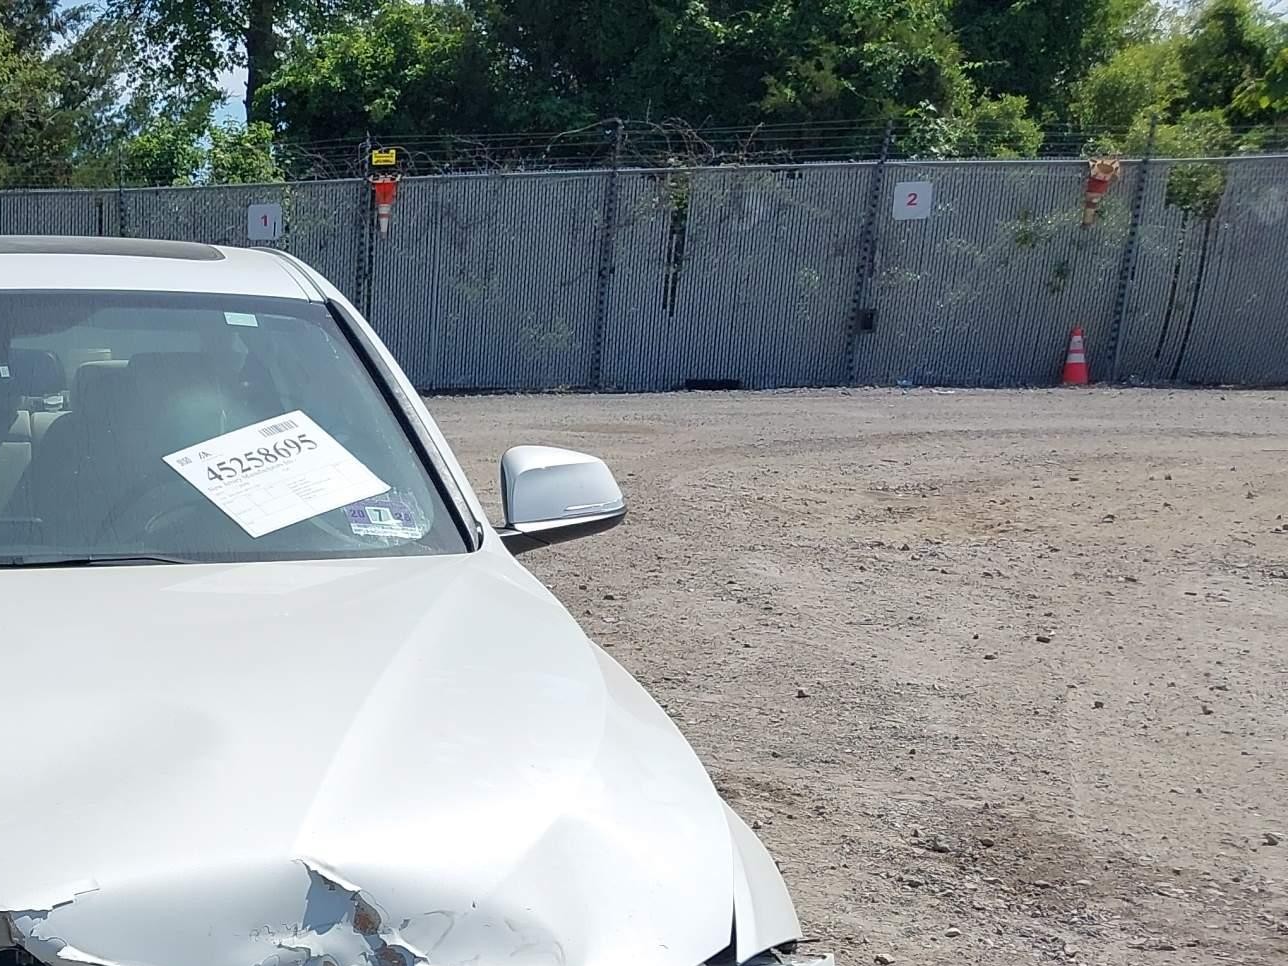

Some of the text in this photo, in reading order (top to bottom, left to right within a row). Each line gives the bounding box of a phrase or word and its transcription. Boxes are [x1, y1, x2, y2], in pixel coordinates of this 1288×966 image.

[906, 192, 918, 206] 2
[260, 214, 268, 227] 1
[207, 434, 318, 481] 45258695
[374, 509, 383, 522] 7
